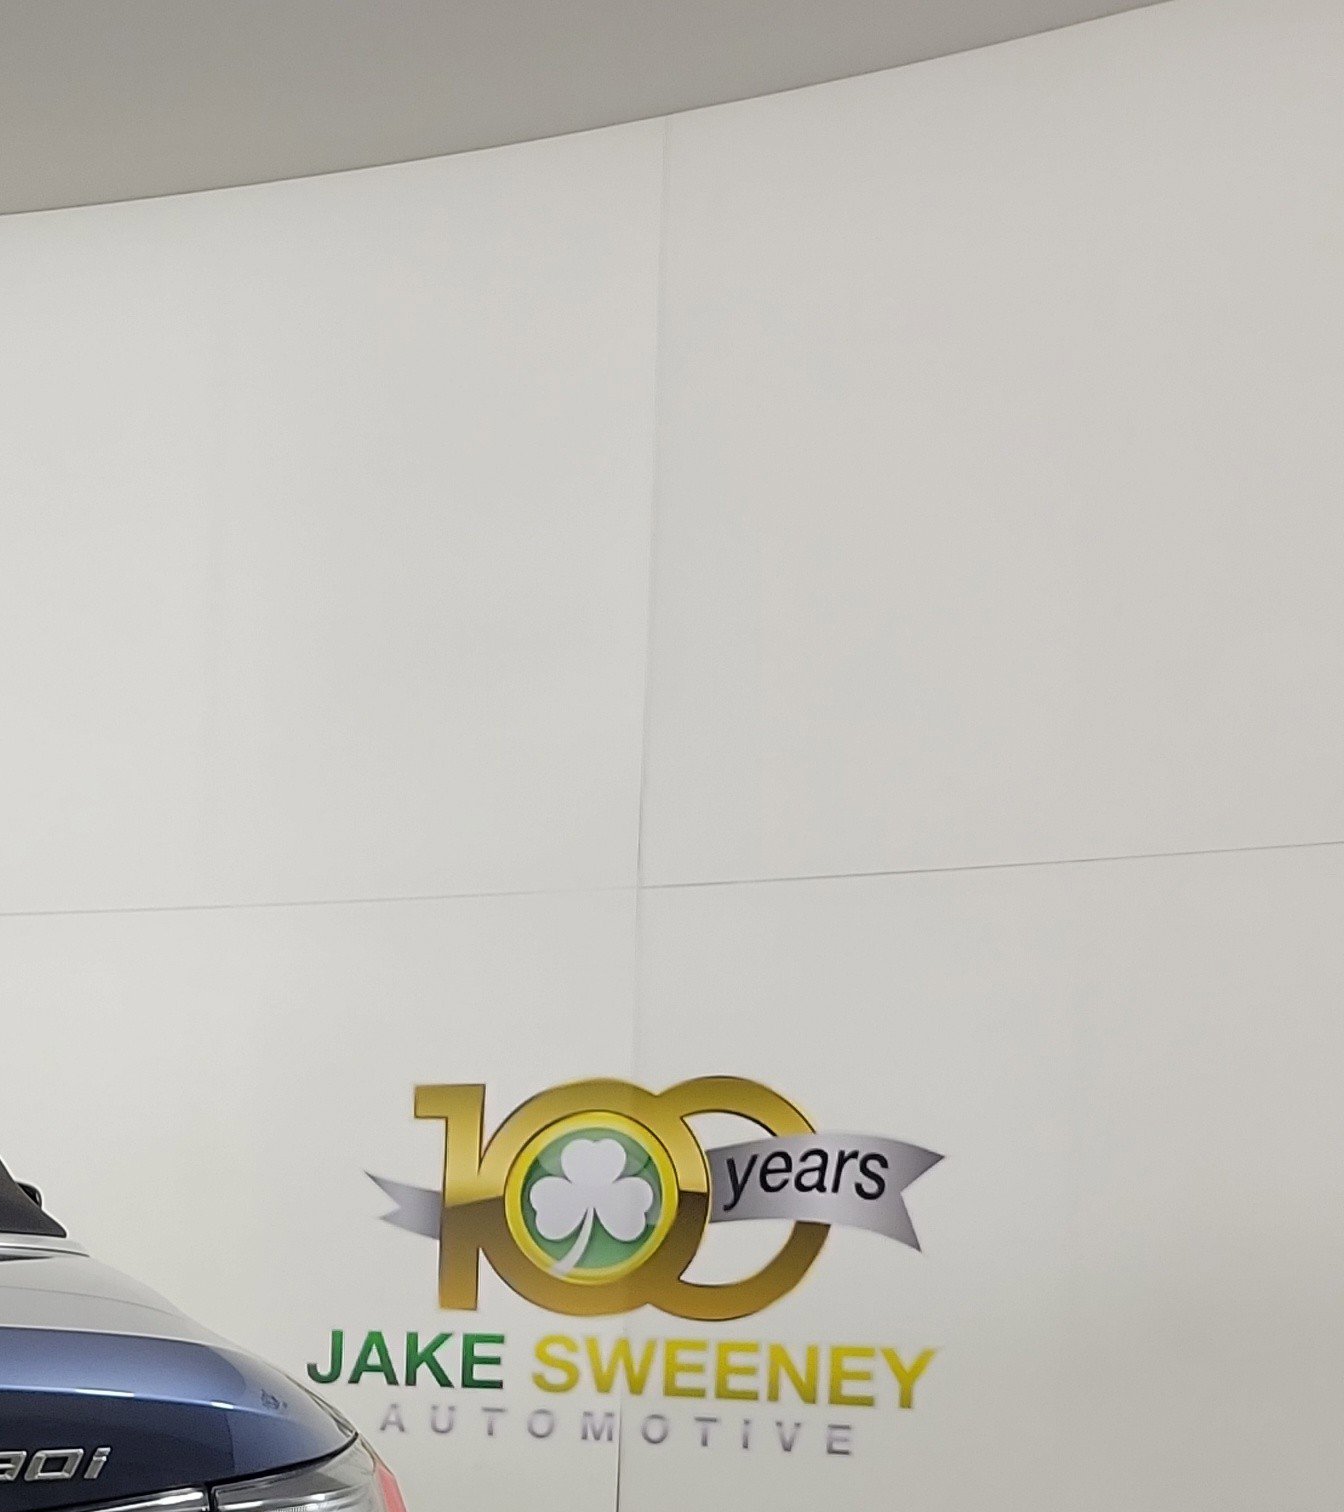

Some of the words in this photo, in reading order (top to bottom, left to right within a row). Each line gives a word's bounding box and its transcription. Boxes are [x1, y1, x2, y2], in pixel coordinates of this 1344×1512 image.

[723, 1146, 890, 1211] years
[306, 1329, 506, 1390] JAKE
[531, 1334, 937, 1410] SWEENEY
[378, 1403, 853, 1456] AUTOMOTIVE
